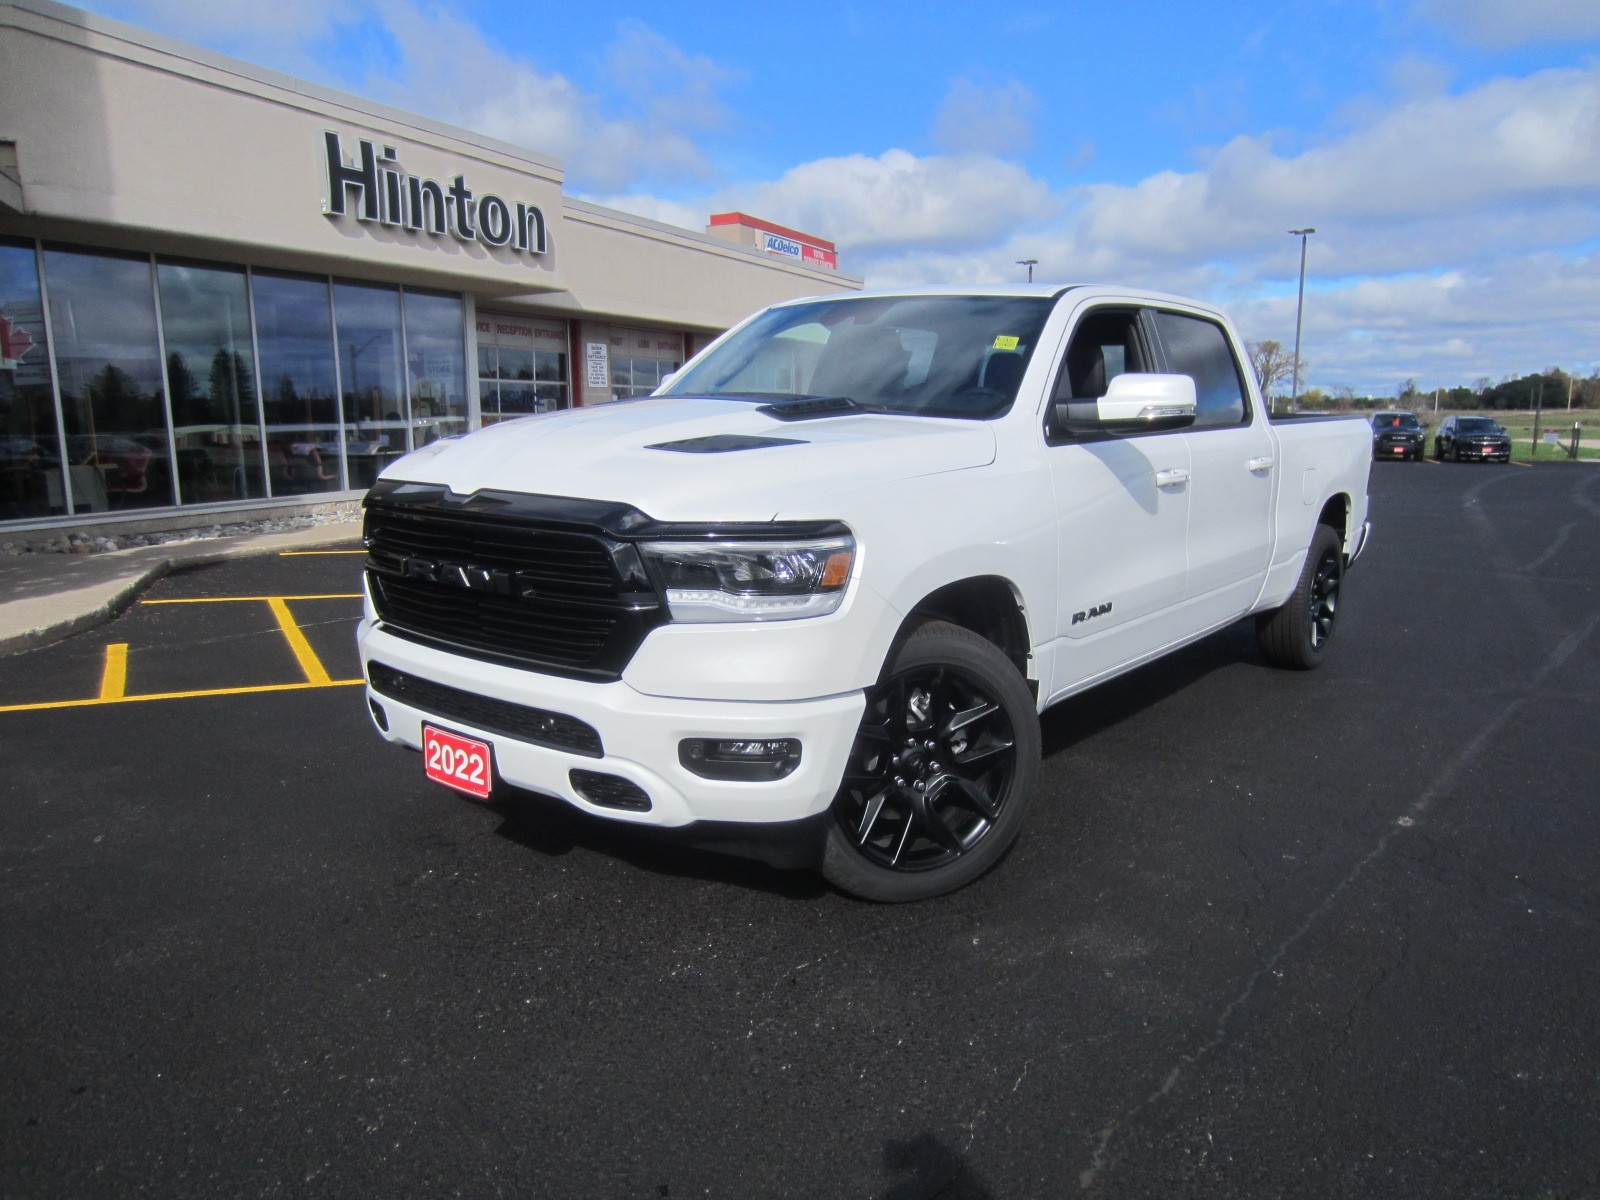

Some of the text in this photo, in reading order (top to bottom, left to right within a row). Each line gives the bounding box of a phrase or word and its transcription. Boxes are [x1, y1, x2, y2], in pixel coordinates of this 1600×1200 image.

[322, 129, 547, 254] Hinton
[767, 237, 799, 256] ACDelco
[497, 324, 533, 337] RECEPTION
[534, 328, 566, 340] ENTRANCE
[637, 339, 651, 349] LUBE
[657, 341, 681, 352] ENTRANCE
[406, 556, 510, 594] RAM
[1072, 602, 1112, 625] RAM
[429, 740, 484, 785] 2022
